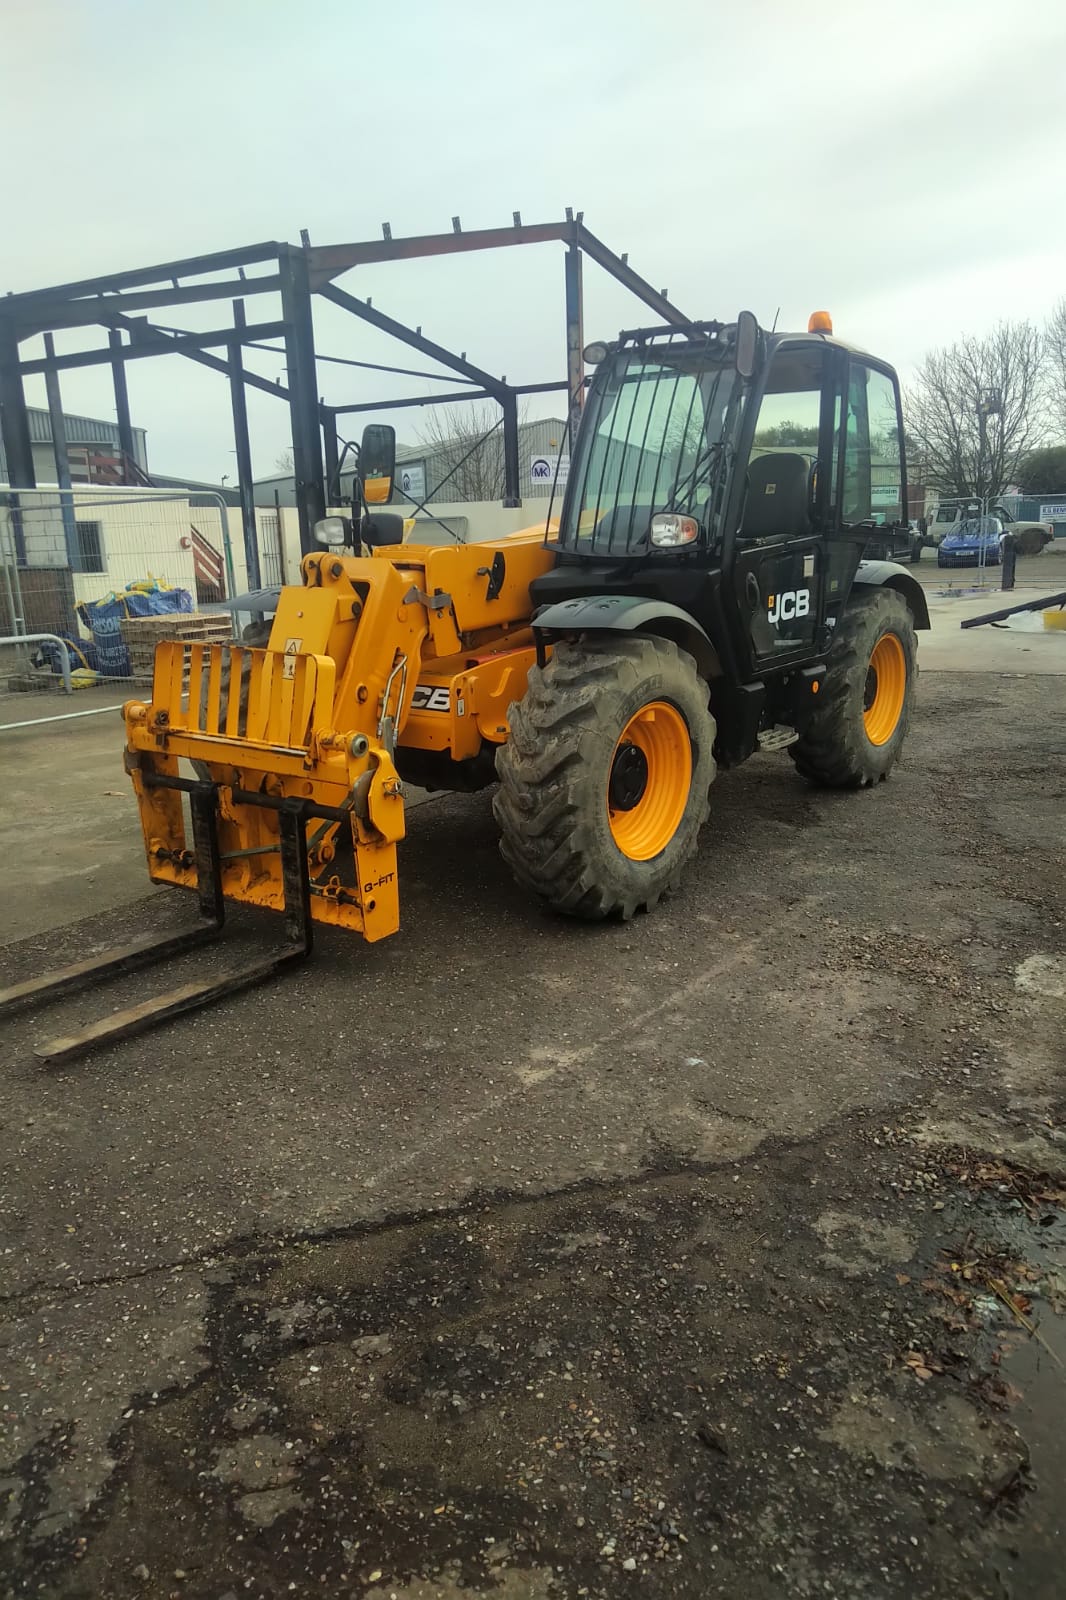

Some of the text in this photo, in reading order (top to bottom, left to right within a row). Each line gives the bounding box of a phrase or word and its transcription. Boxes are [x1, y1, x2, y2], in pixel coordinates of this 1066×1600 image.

[535, 467, 547, 477] MK
[768, 589, 809, 623] JCB
[411, 686, 450, 710] CB
